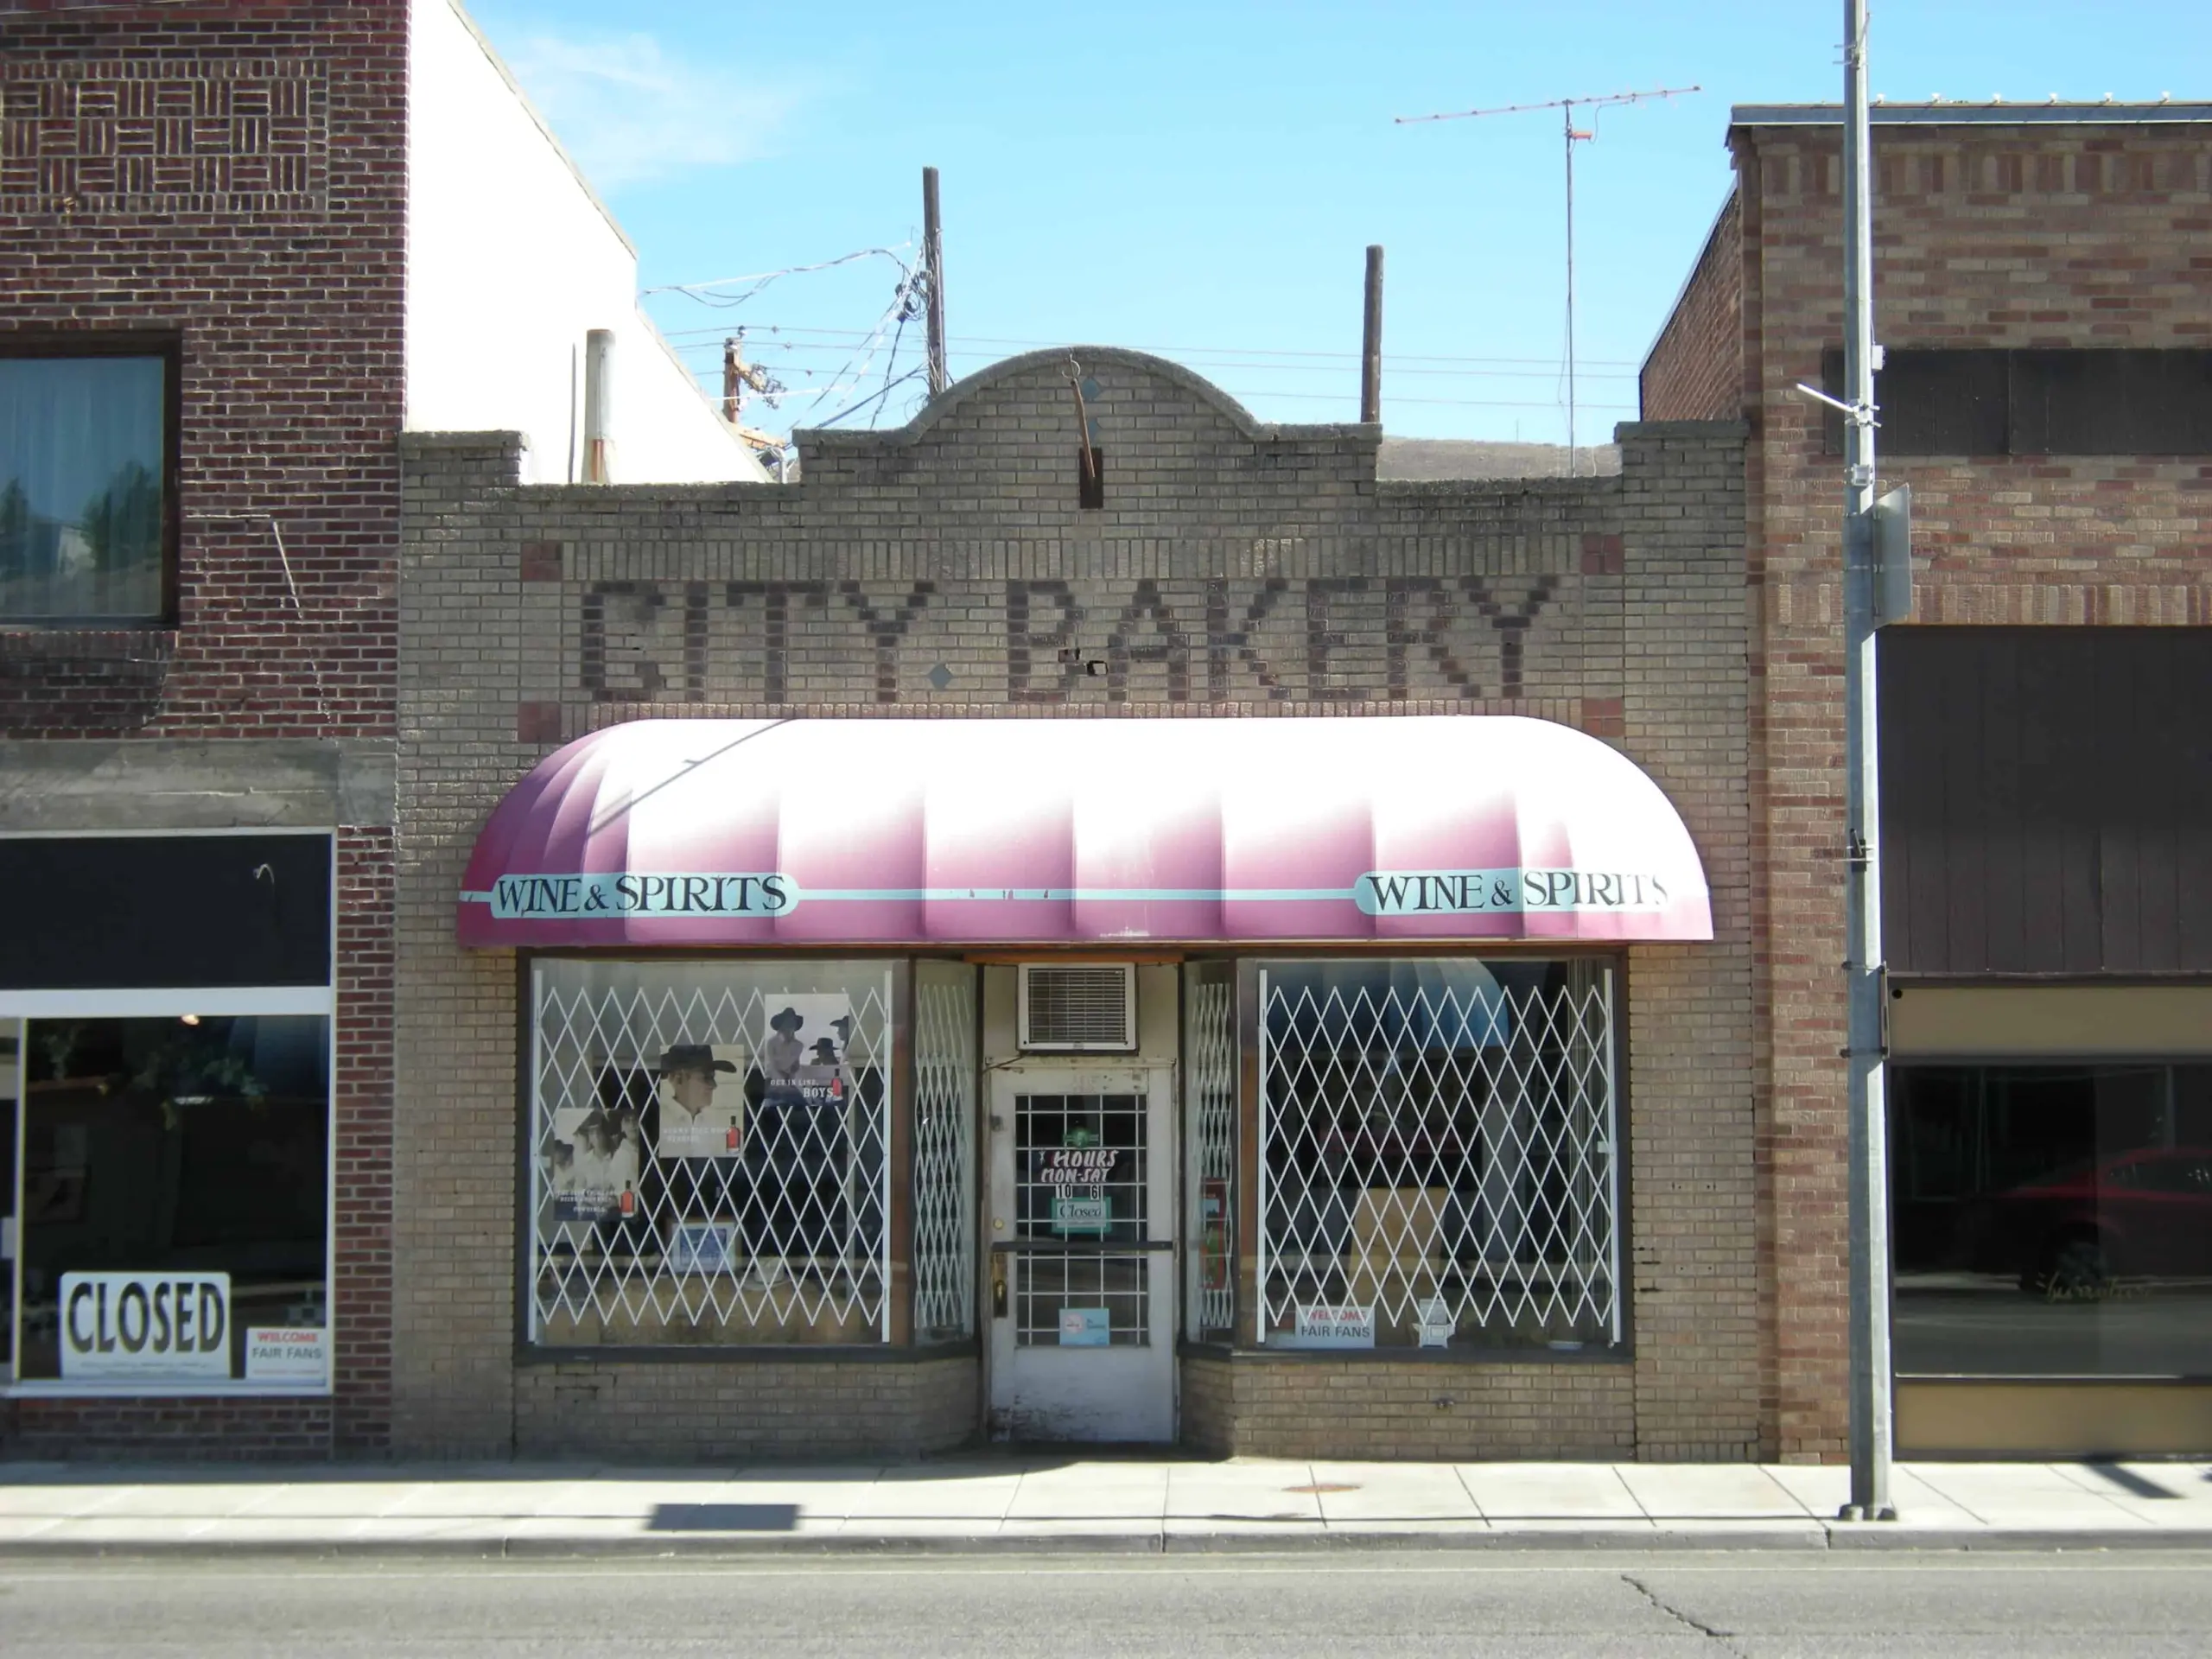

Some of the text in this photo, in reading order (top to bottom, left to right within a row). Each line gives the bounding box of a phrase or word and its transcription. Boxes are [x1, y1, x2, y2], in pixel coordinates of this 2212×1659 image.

[581, 578, 1559, 702] CITY BAKERY
[499, 875, 787, 912] WINE & SPIRITS
[1367, 871, 1669, 911] WINE & SPIRITS
[1052, 1150, 1119, 1168] HOURS
[1040, 1168, 1110, 1183] MON-SAT
[1058, 1185, 1100, 1199] 10 6
[1059, 1204, 1102, 1218] Closed
[68, 1281, 225, 1353] CLOSED
[257, 1332, 318, 1343] WELCOME
[1301, 1325, 1370, 1338] FAIR FANS
[252, 1347, 321, 1359] FAIR FANS
